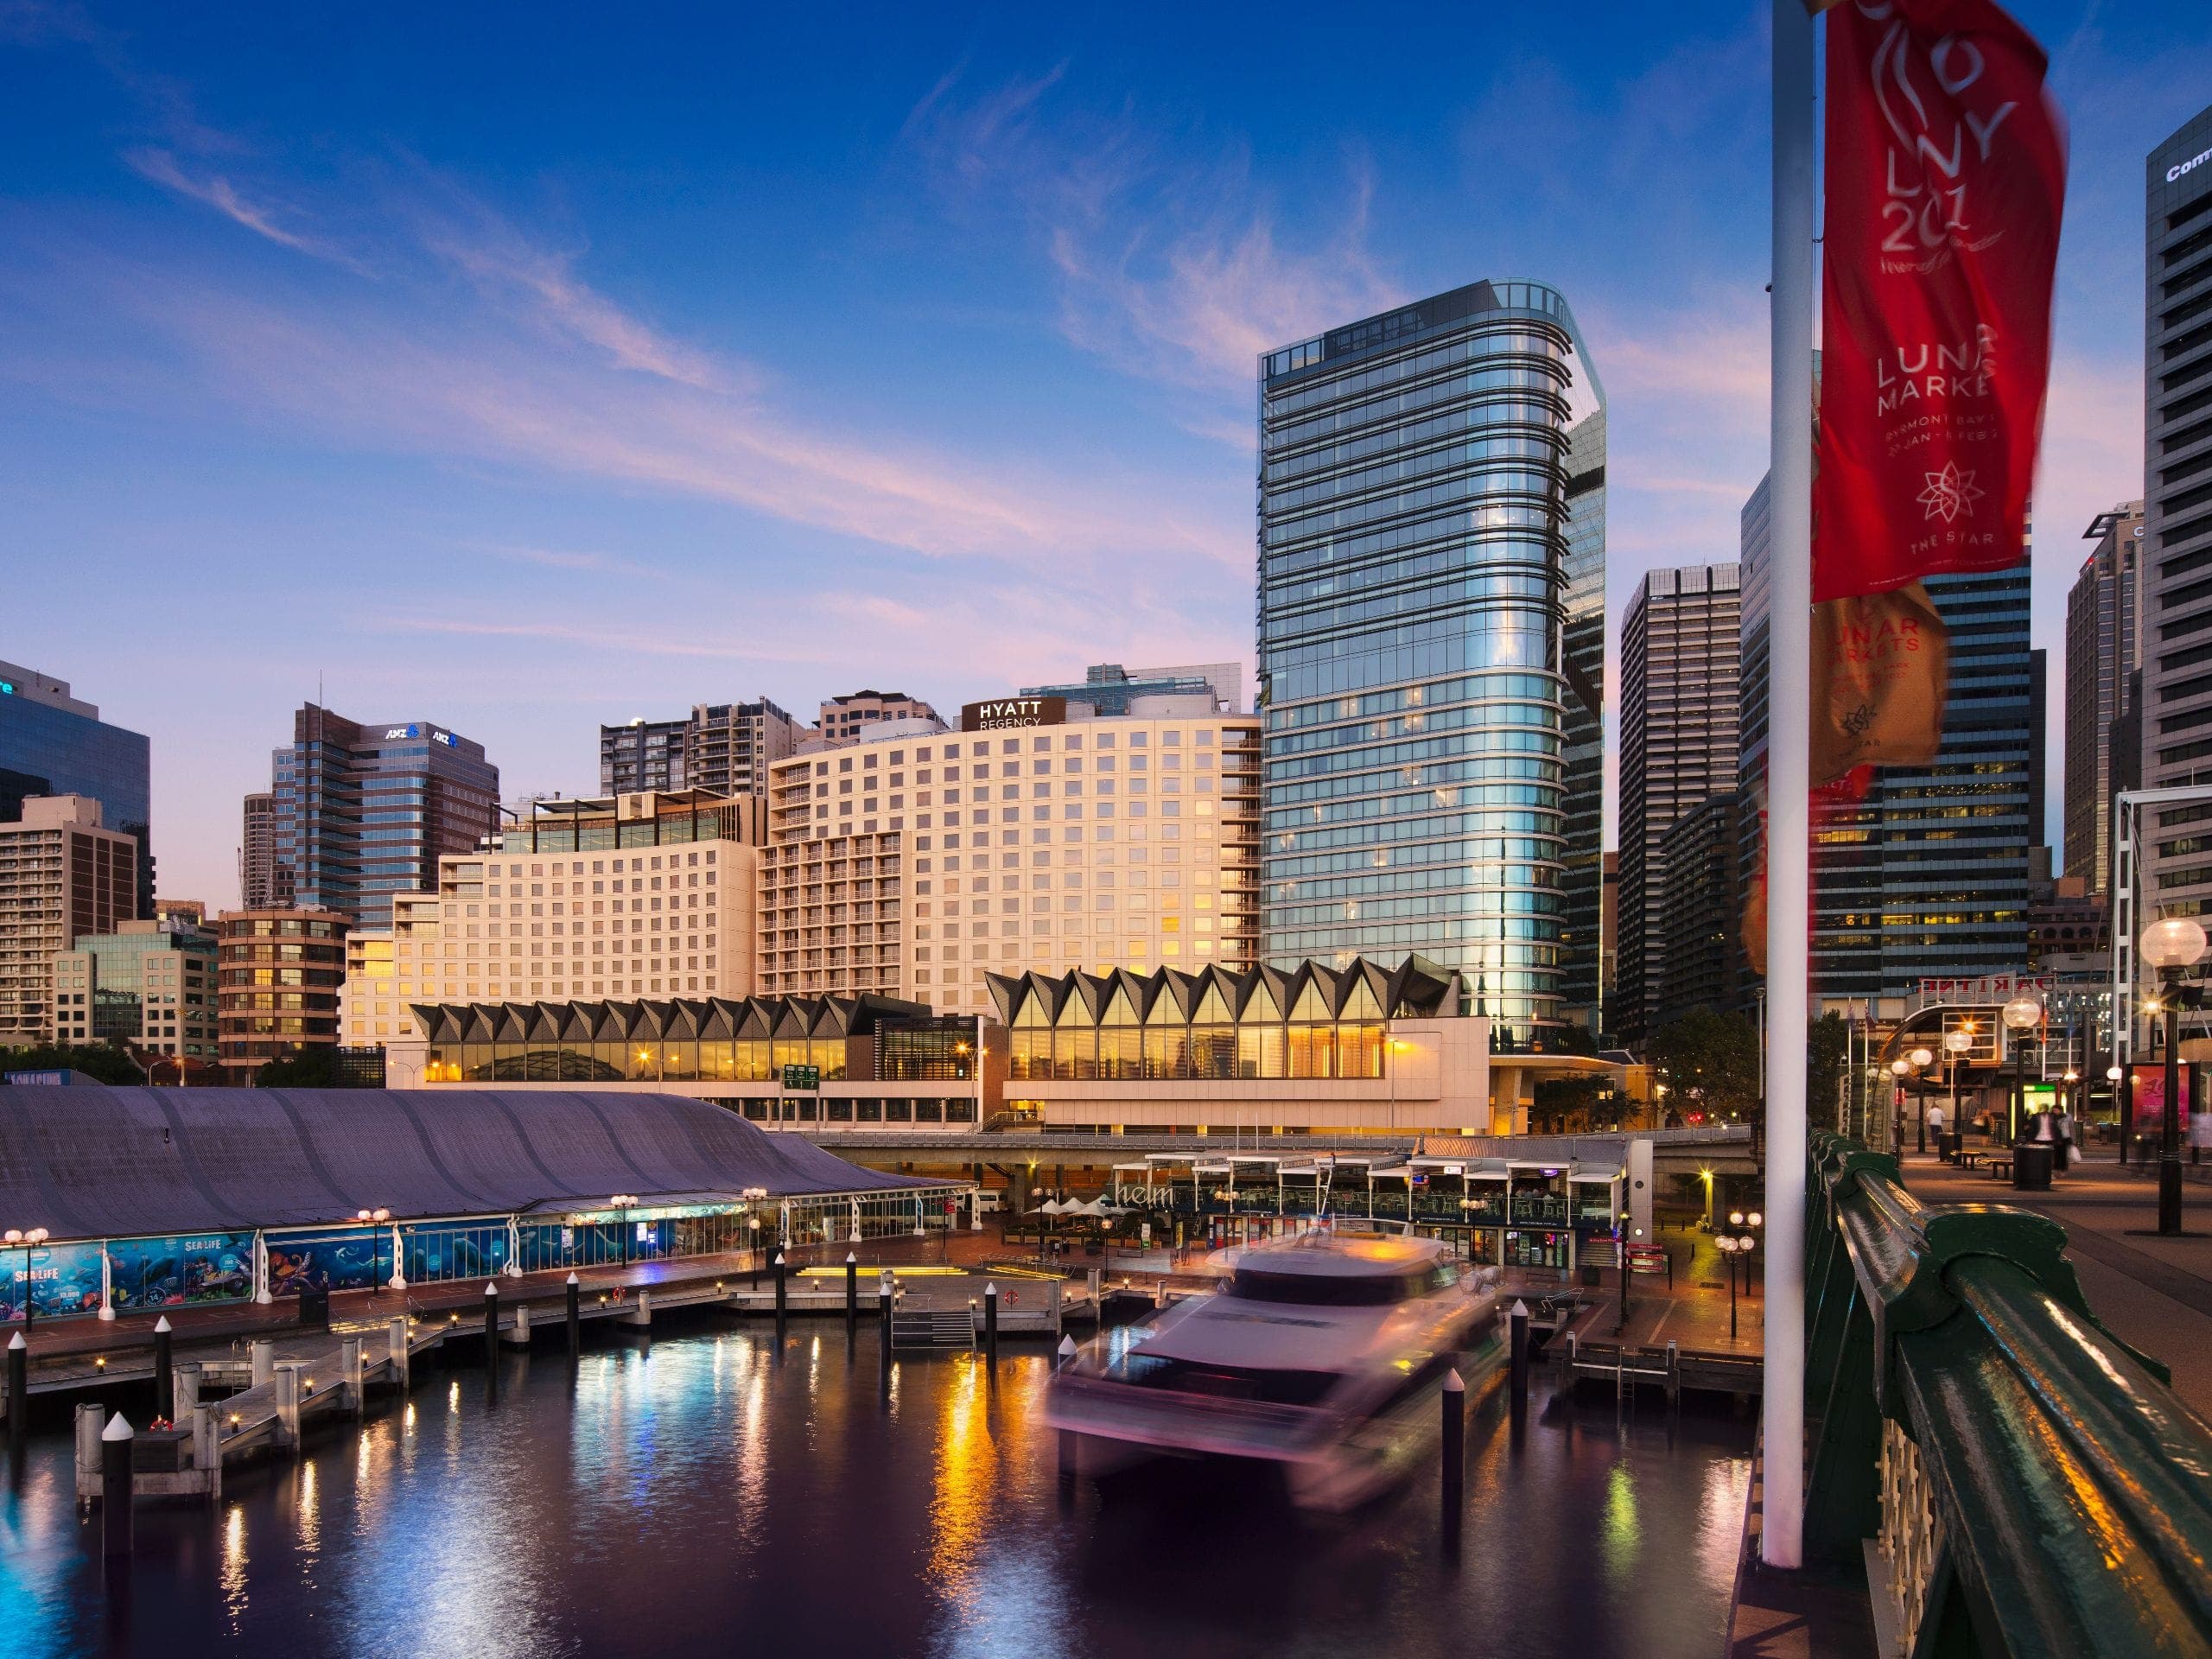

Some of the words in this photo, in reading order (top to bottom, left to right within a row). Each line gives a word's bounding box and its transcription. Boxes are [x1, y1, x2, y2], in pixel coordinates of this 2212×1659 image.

[2165, 147, 2212, 182] Com
[1881, 182, 1970, 251] 201
[1910, 533, 1939, 556] THE
[1947, 530, 1995, 546] STAR
[980, 701, 1042, 719] HYATT
[385, 728, 407, 740] ANZ
[980, 717, 1041, 731] REGENCY
[433, 731, 449, 745] ANZ
[1115, 1183, 1173, 1206] helm
